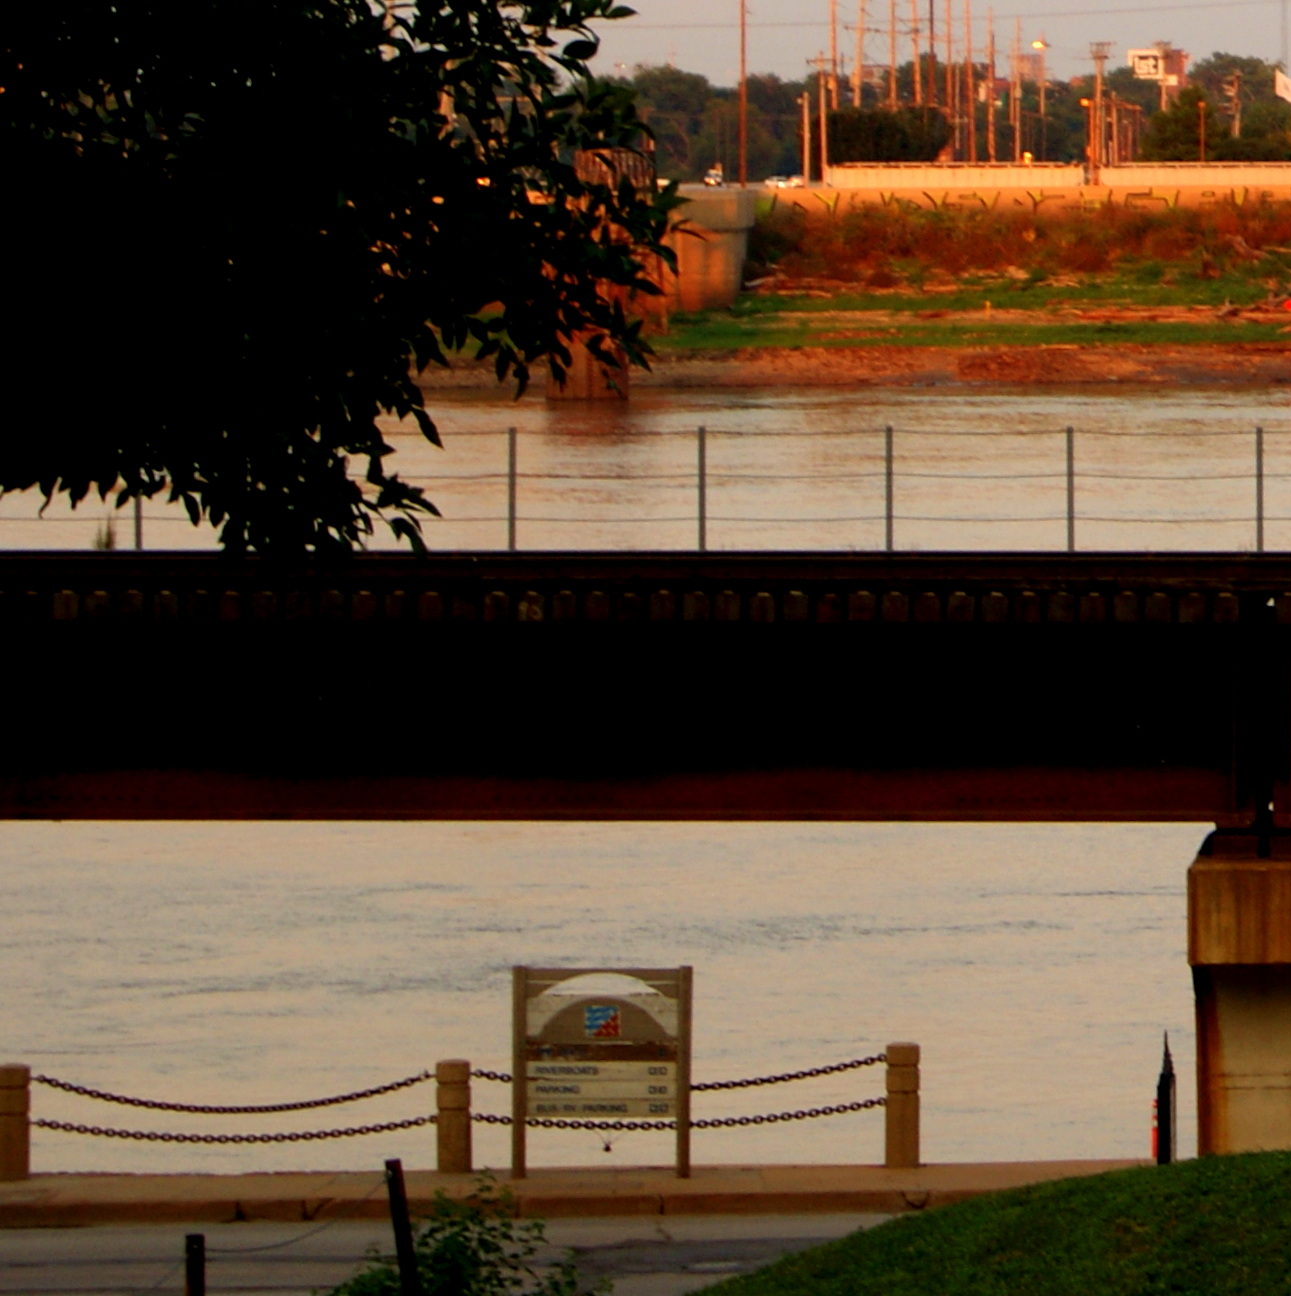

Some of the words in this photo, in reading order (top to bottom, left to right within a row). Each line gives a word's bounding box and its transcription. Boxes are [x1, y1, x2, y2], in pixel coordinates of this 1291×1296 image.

[535, 1066, 599, 1075] RIVERBOATS
[535, 1085, 580, 1094] PARKING
[582, 1104, 628, 1113] PARKING
